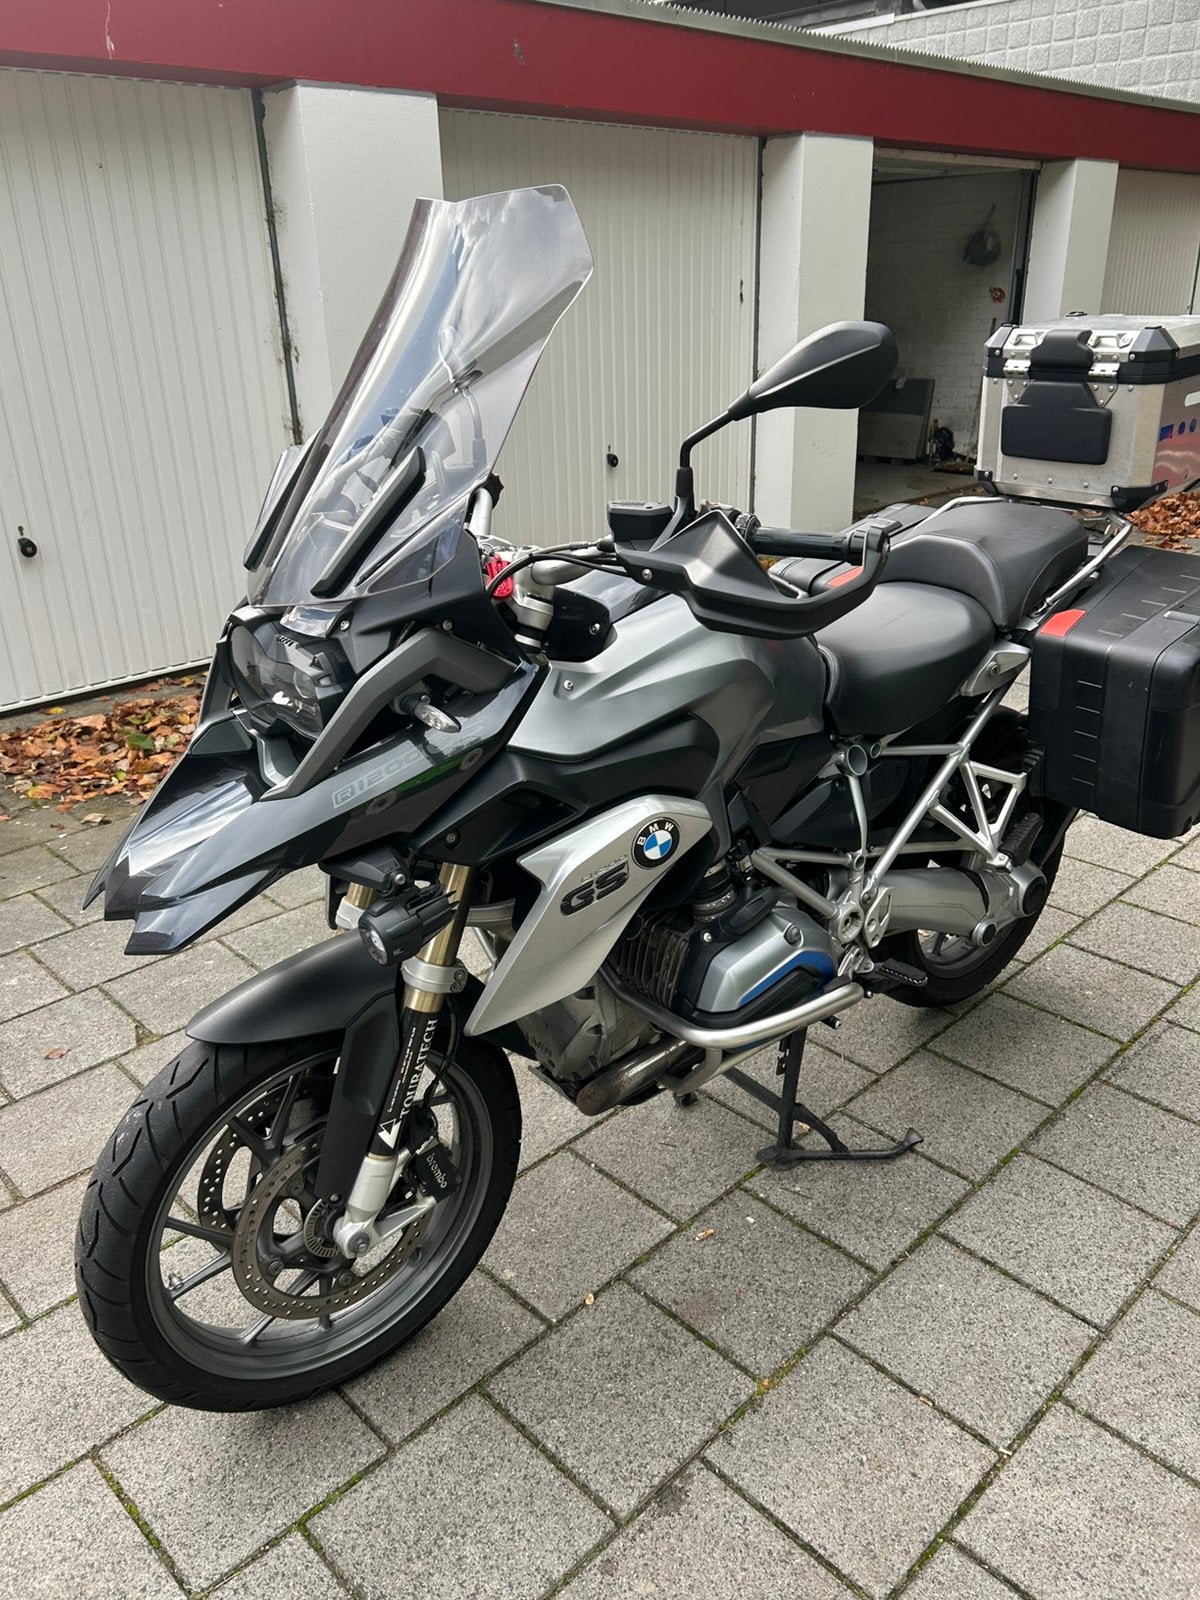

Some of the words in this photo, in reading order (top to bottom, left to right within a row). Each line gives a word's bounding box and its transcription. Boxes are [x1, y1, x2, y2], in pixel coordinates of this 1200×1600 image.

[636, 821, 674, 846] BMW
[560, 860, 630, 917] GS
[399, 1019, 438, 1119] TOURATECH
[425, 1152, 448, 1189] brembo
